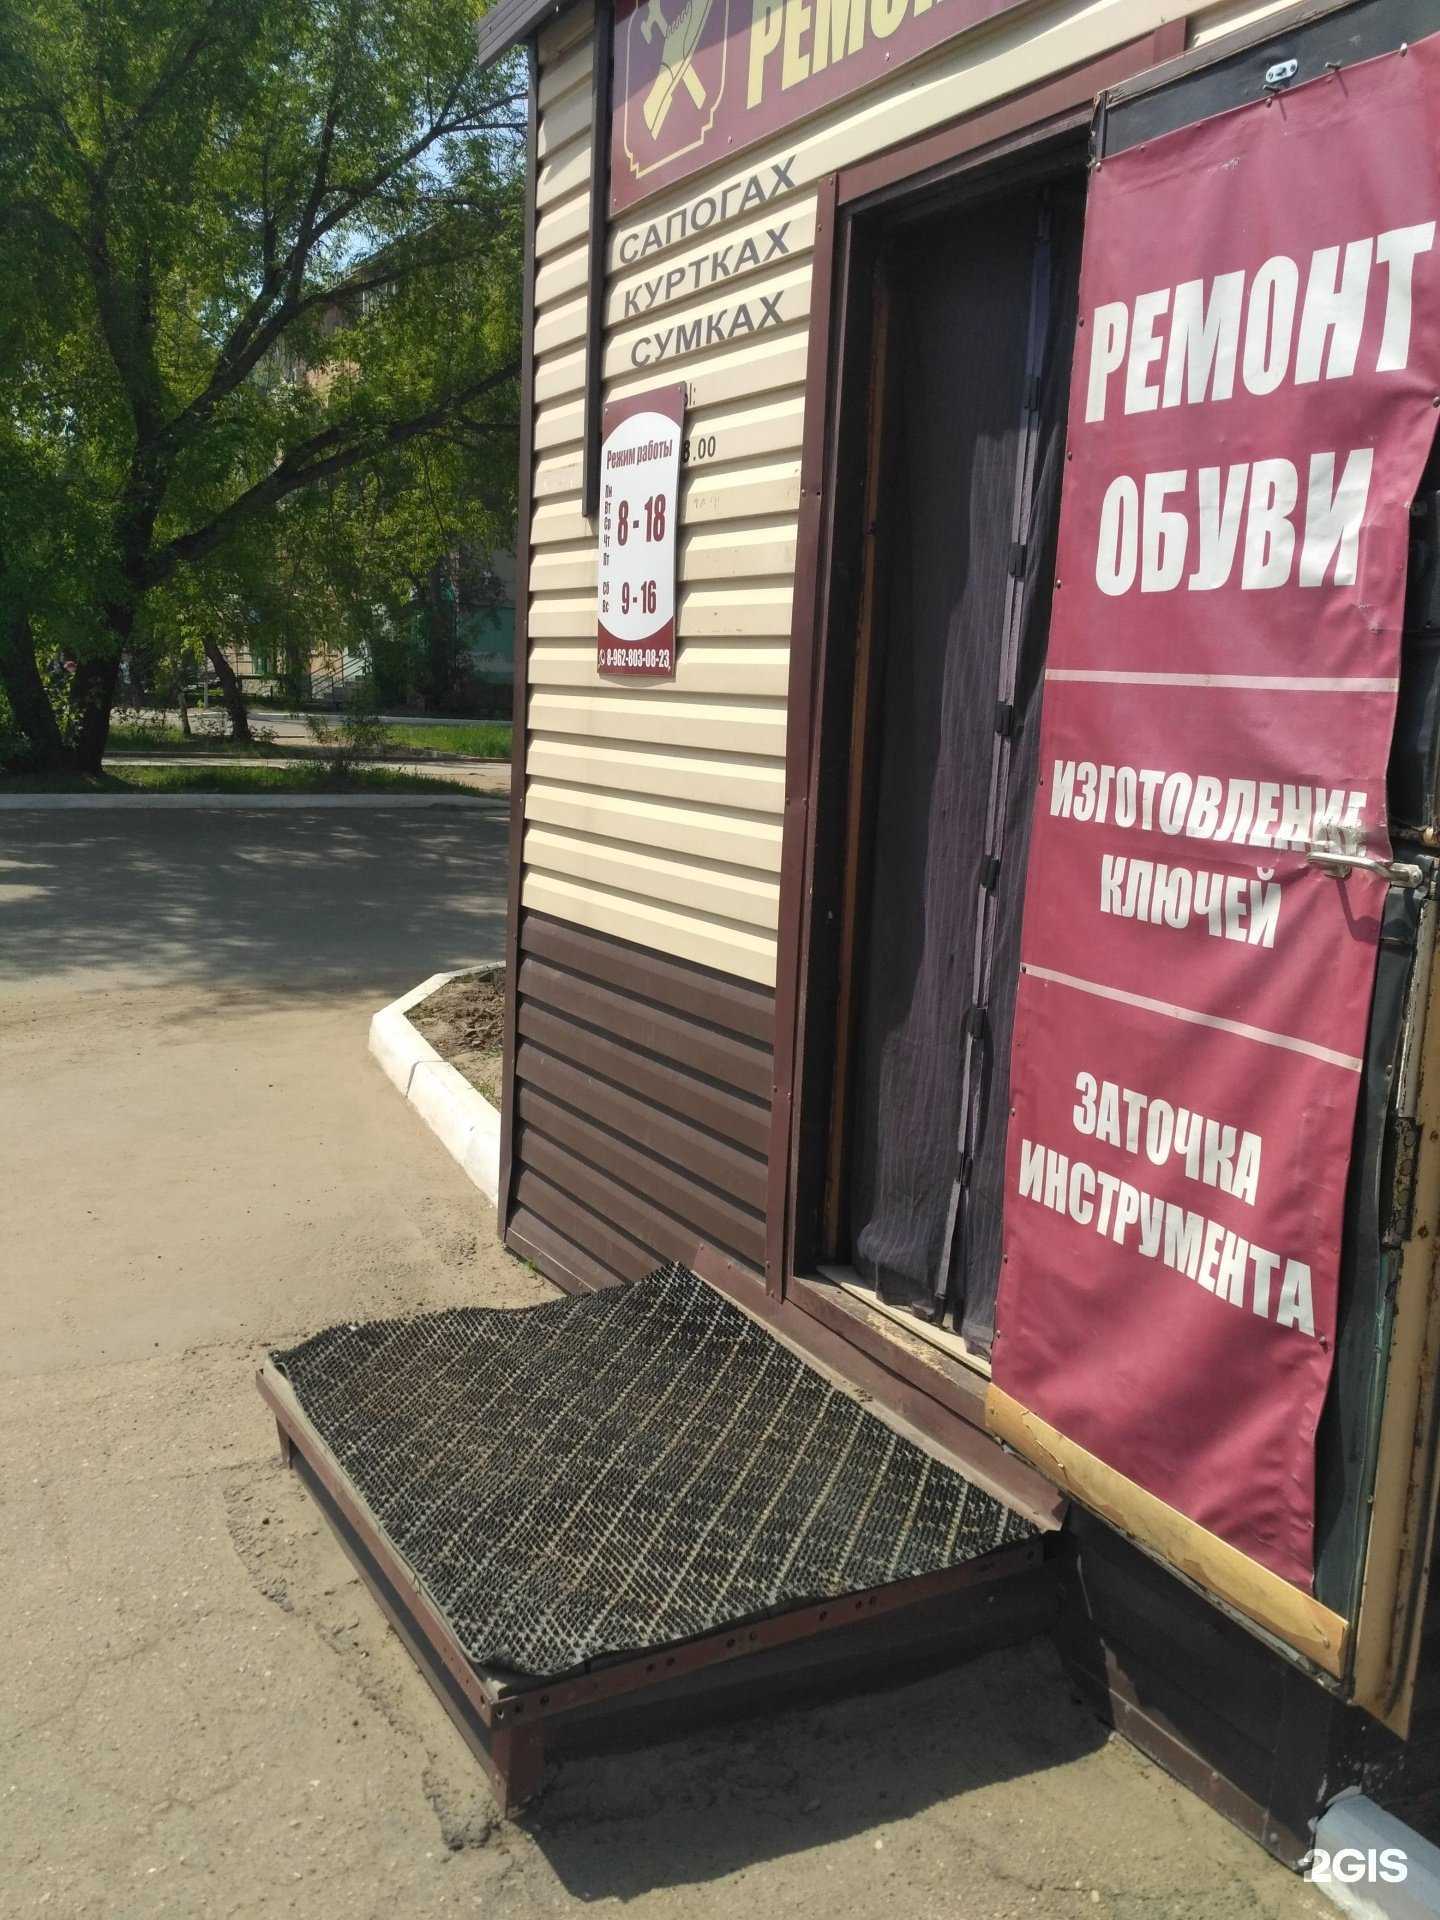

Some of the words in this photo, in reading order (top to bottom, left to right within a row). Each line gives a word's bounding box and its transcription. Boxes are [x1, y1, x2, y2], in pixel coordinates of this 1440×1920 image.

[619, 154, 798, 264] САПОГАХ
[624, 221, 791, 319] КУРТКАХ
[1085, 221, 1437, 423] РЕМОНТ
[630, 290, 785, 368] СУМКАХ
[606, 447, 636, 470] Режим
[636, 440, 673, 465] работы
[1095, 448, 1374, 597] ОБУВИ
[1050, 759, 1368, 857] ИЗГОТОВЛЕНИЕ
[1100, 855, 1281, 949] КЛЮЧЕЙ
[1073, 1072, 1262, 1205] ЗАТОЧКА
[1018, 1139, 1316, 1337] ИНСТРУМЕНТА
